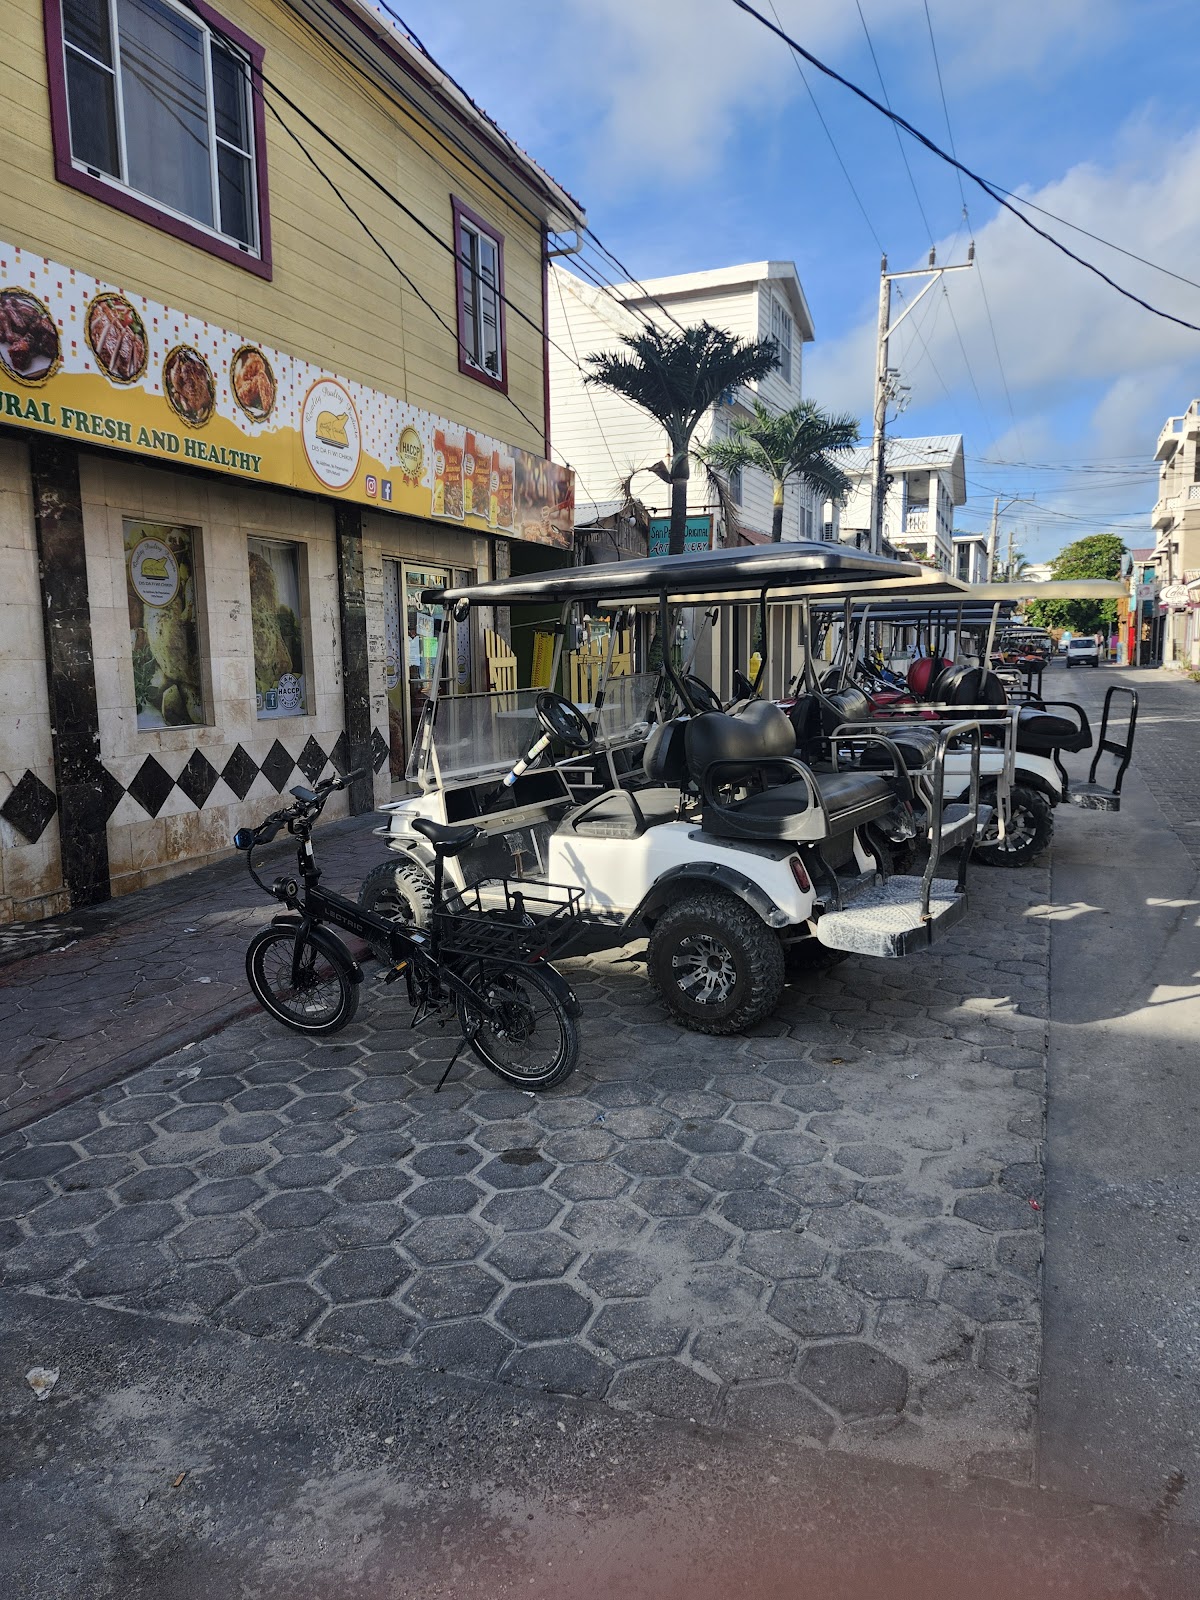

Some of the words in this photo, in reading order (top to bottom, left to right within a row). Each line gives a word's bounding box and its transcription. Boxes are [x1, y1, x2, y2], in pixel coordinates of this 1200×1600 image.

[321, 386, 344, 405] Poultry
[60, 406, 132, 443] FRESH
[136, 426, 180, 453] AND
[184, 438, 262, 472] HEALTHY
[402, 441, 421, 458] HACCP
[650, 541, 670, 555] ART
[278, 687, 300, 695] HACCP
[324, 907, 363, 932] LECTRIC
